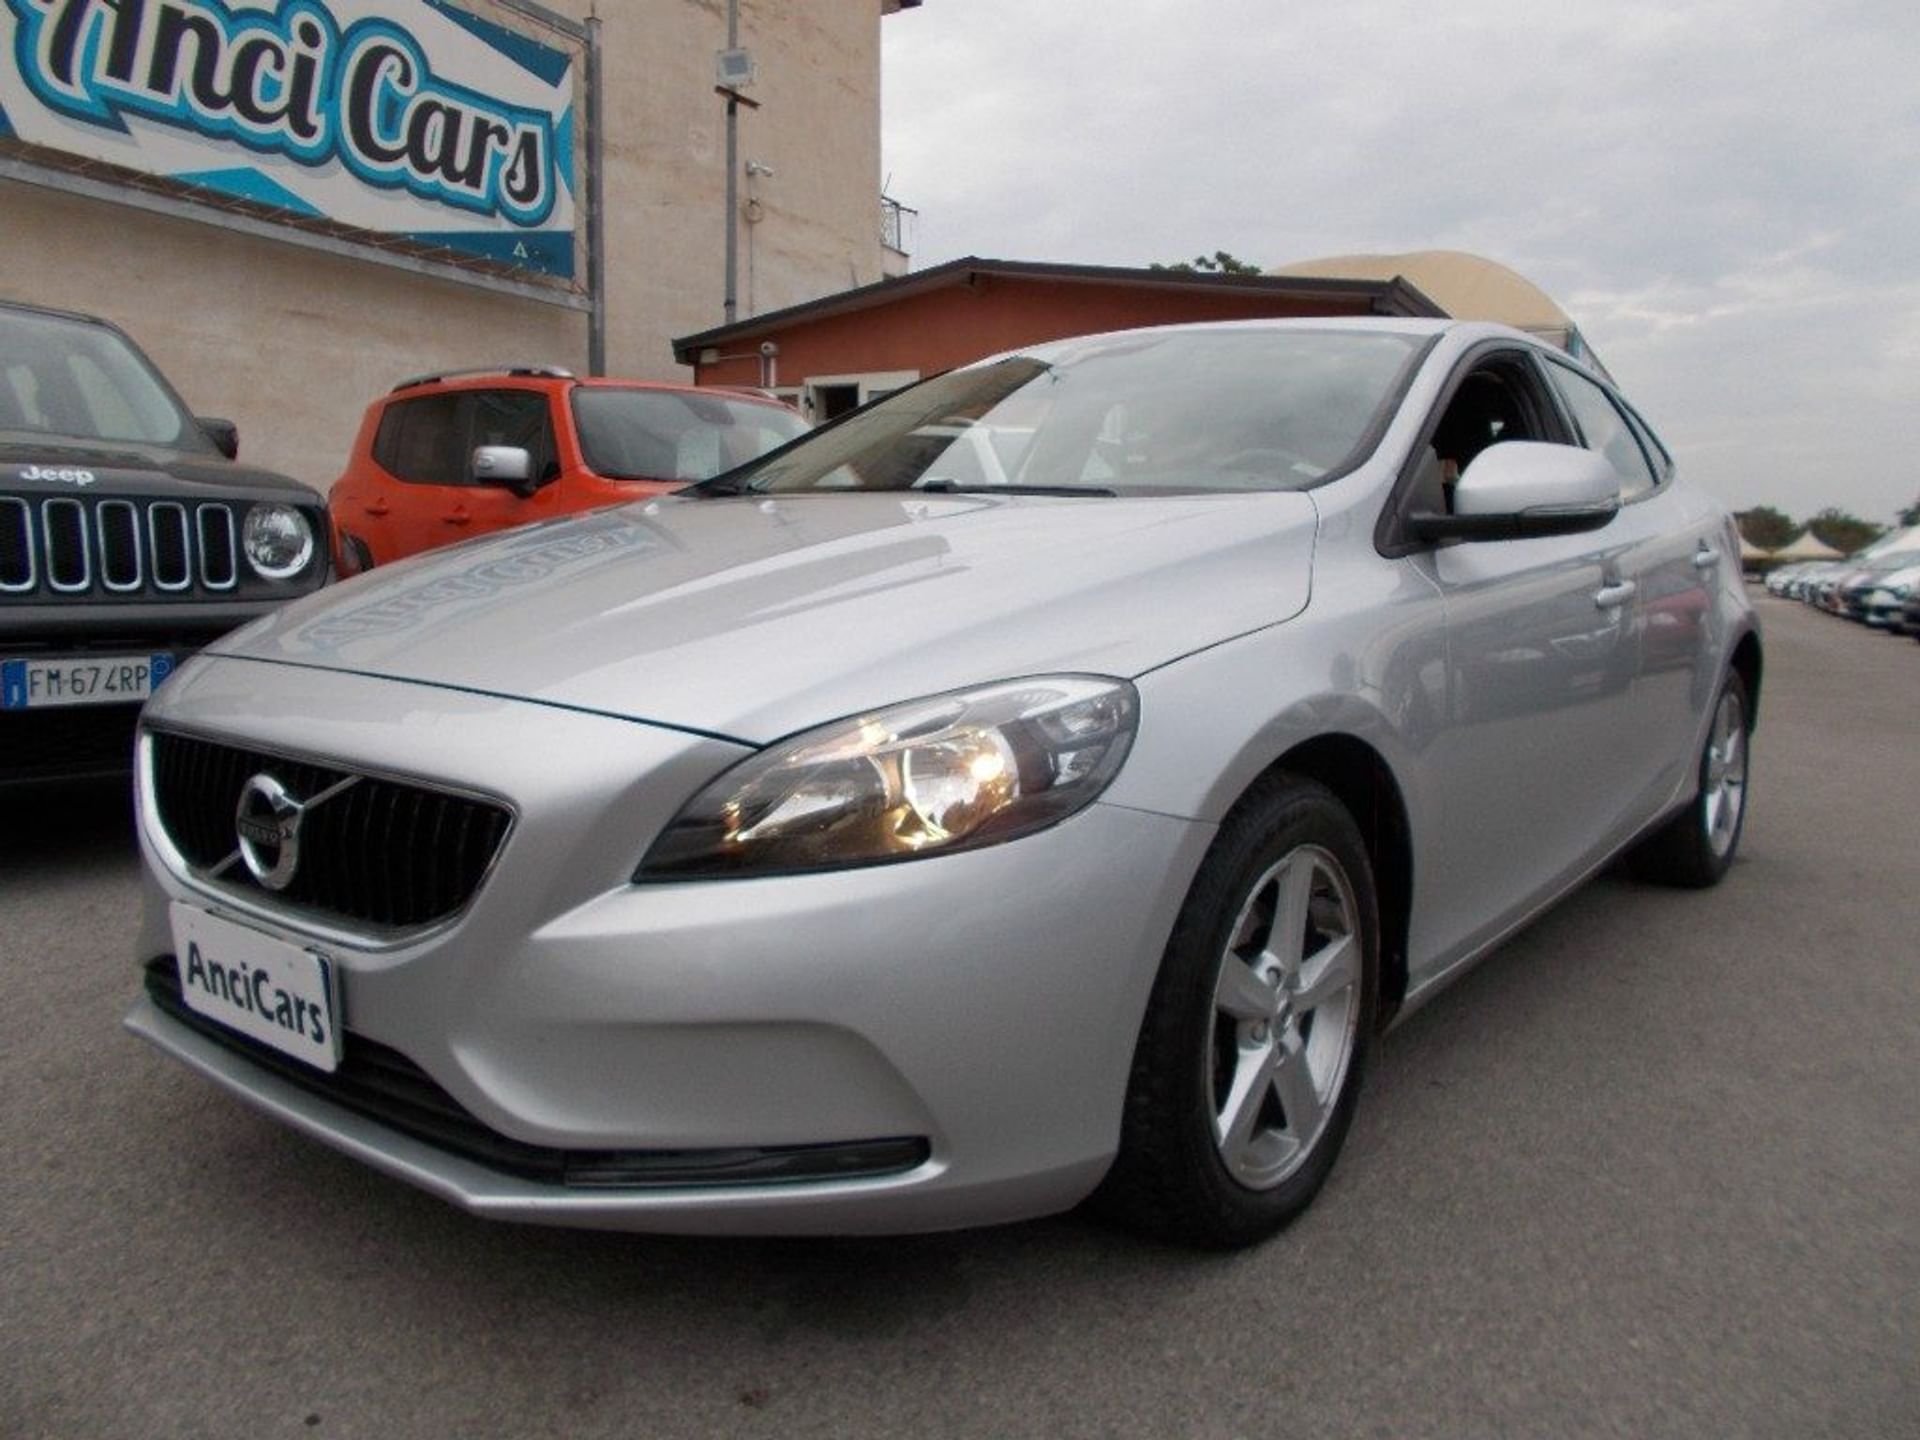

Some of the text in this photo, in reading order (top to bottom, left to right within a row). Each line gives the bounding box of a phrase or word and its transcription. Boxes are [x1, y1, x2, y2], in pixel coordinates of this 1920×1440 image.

[348, 45, 541, 204] Cars
[20, 465, 95, 485] Jeep
[187, 941, 325, 1045] AnciCars
